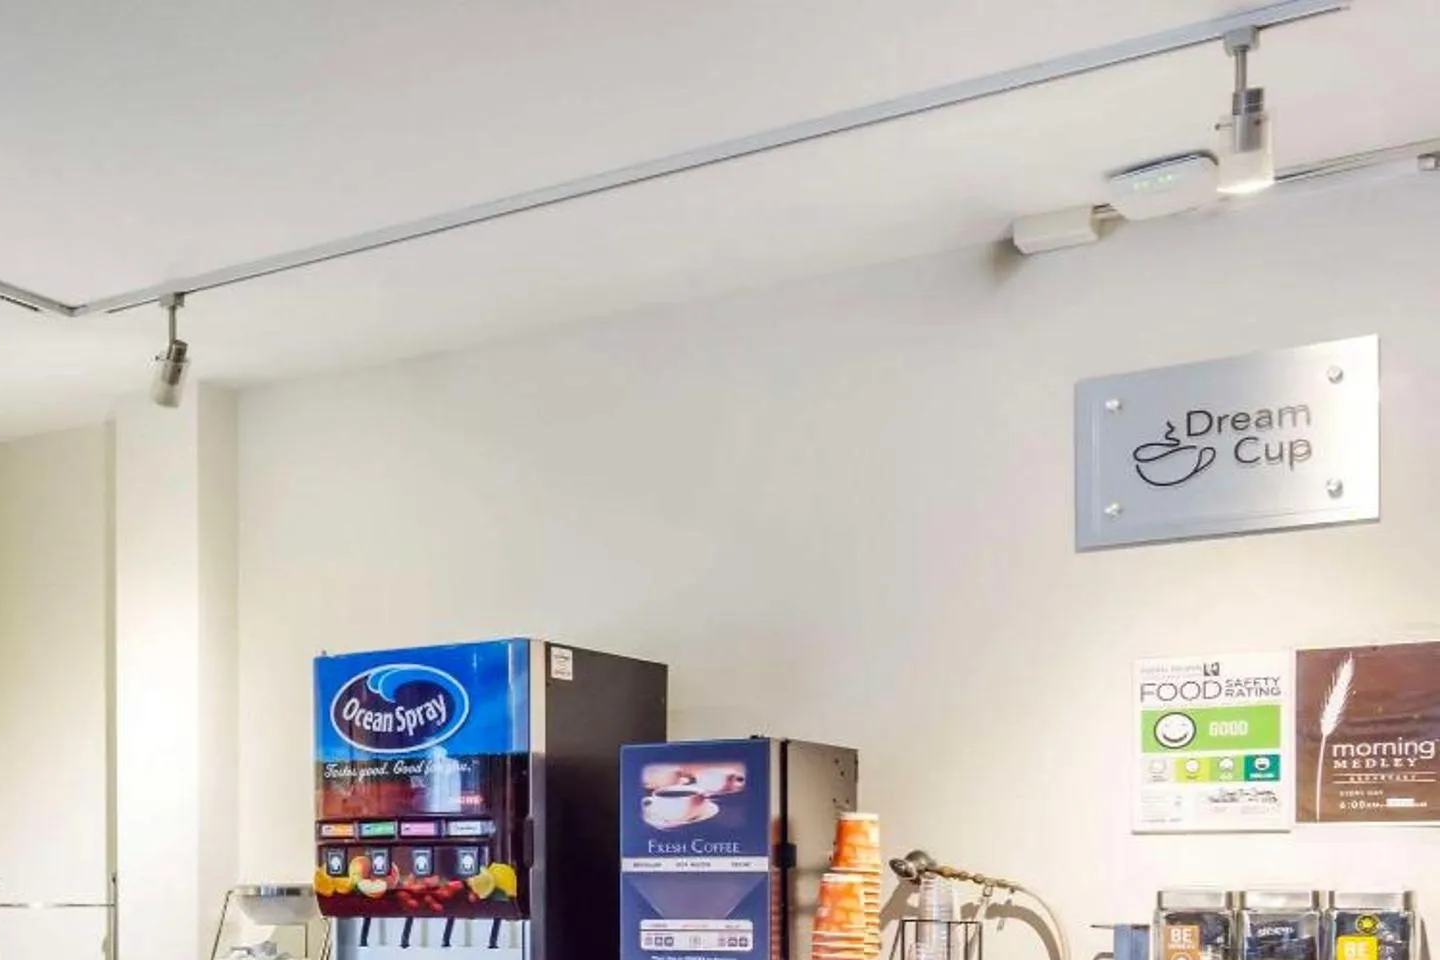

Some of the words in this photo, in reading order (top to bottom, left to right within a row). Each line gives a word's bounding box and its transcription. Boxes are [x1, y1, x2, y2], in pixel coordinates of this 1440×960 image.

[1186, 404, 1311, 437] Dream
[1233, 437, 1312, 470] Cup
[1140, 679, 1222, 702] FOOD
[1225, 686, 1282, 698] RATING
[342, 697, 393, 732] Ocean
[394, 694, 447, 736] Spray
[1208, 721, 1249, 736] GOOD
[1332, 736, 1436, 760] morning
[1333, 757, 1417, 769] MEDLEY
[690, 838, 741, 854] COFFEE
[1171, 928, 1193, 944] BE
